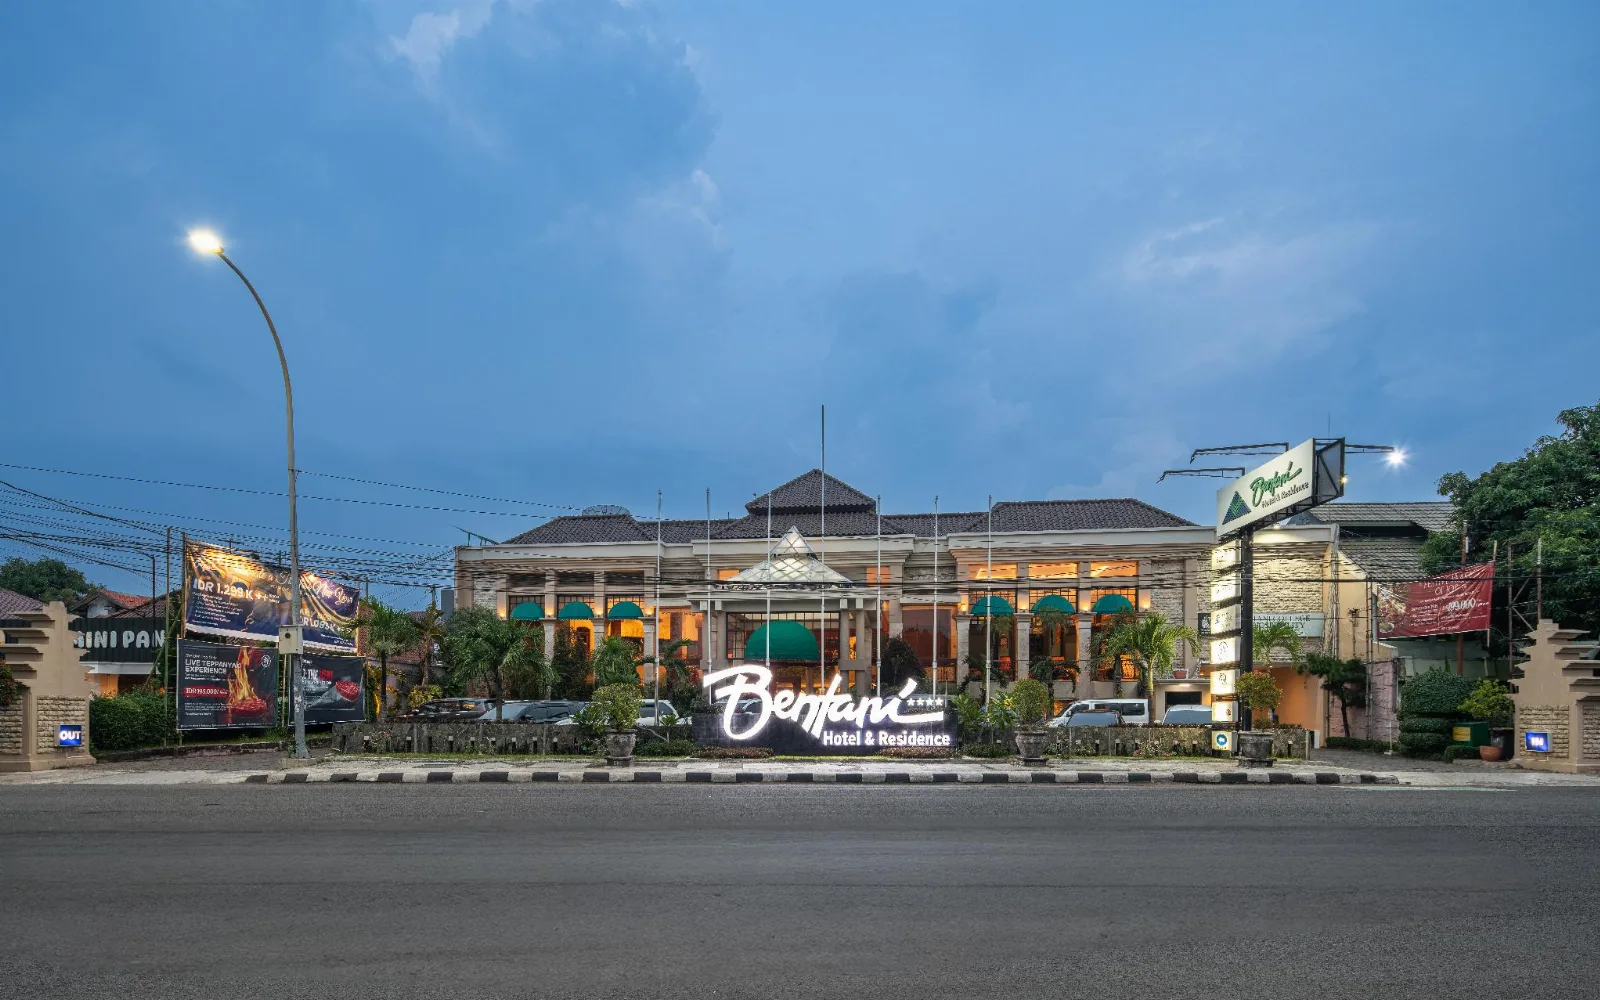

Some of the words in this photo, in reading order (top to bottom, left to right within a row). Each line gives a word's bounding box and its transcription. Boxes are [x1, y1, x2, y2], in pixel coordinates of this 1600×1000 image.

[193, 578, 214, 592] IDR
[185, 659, 201, 667] LIVE
[185, 666, 227, 674] EXPERIENCE
[703, 664, 945, 740] Bentani
[59, 730, 81, 741] OUT
[823, 731, 861, 745] Hotel
[864, 731, 875, 745] &
[878, 731, 951, 745] Residence
[1531, 737, 1544, 746] IN
